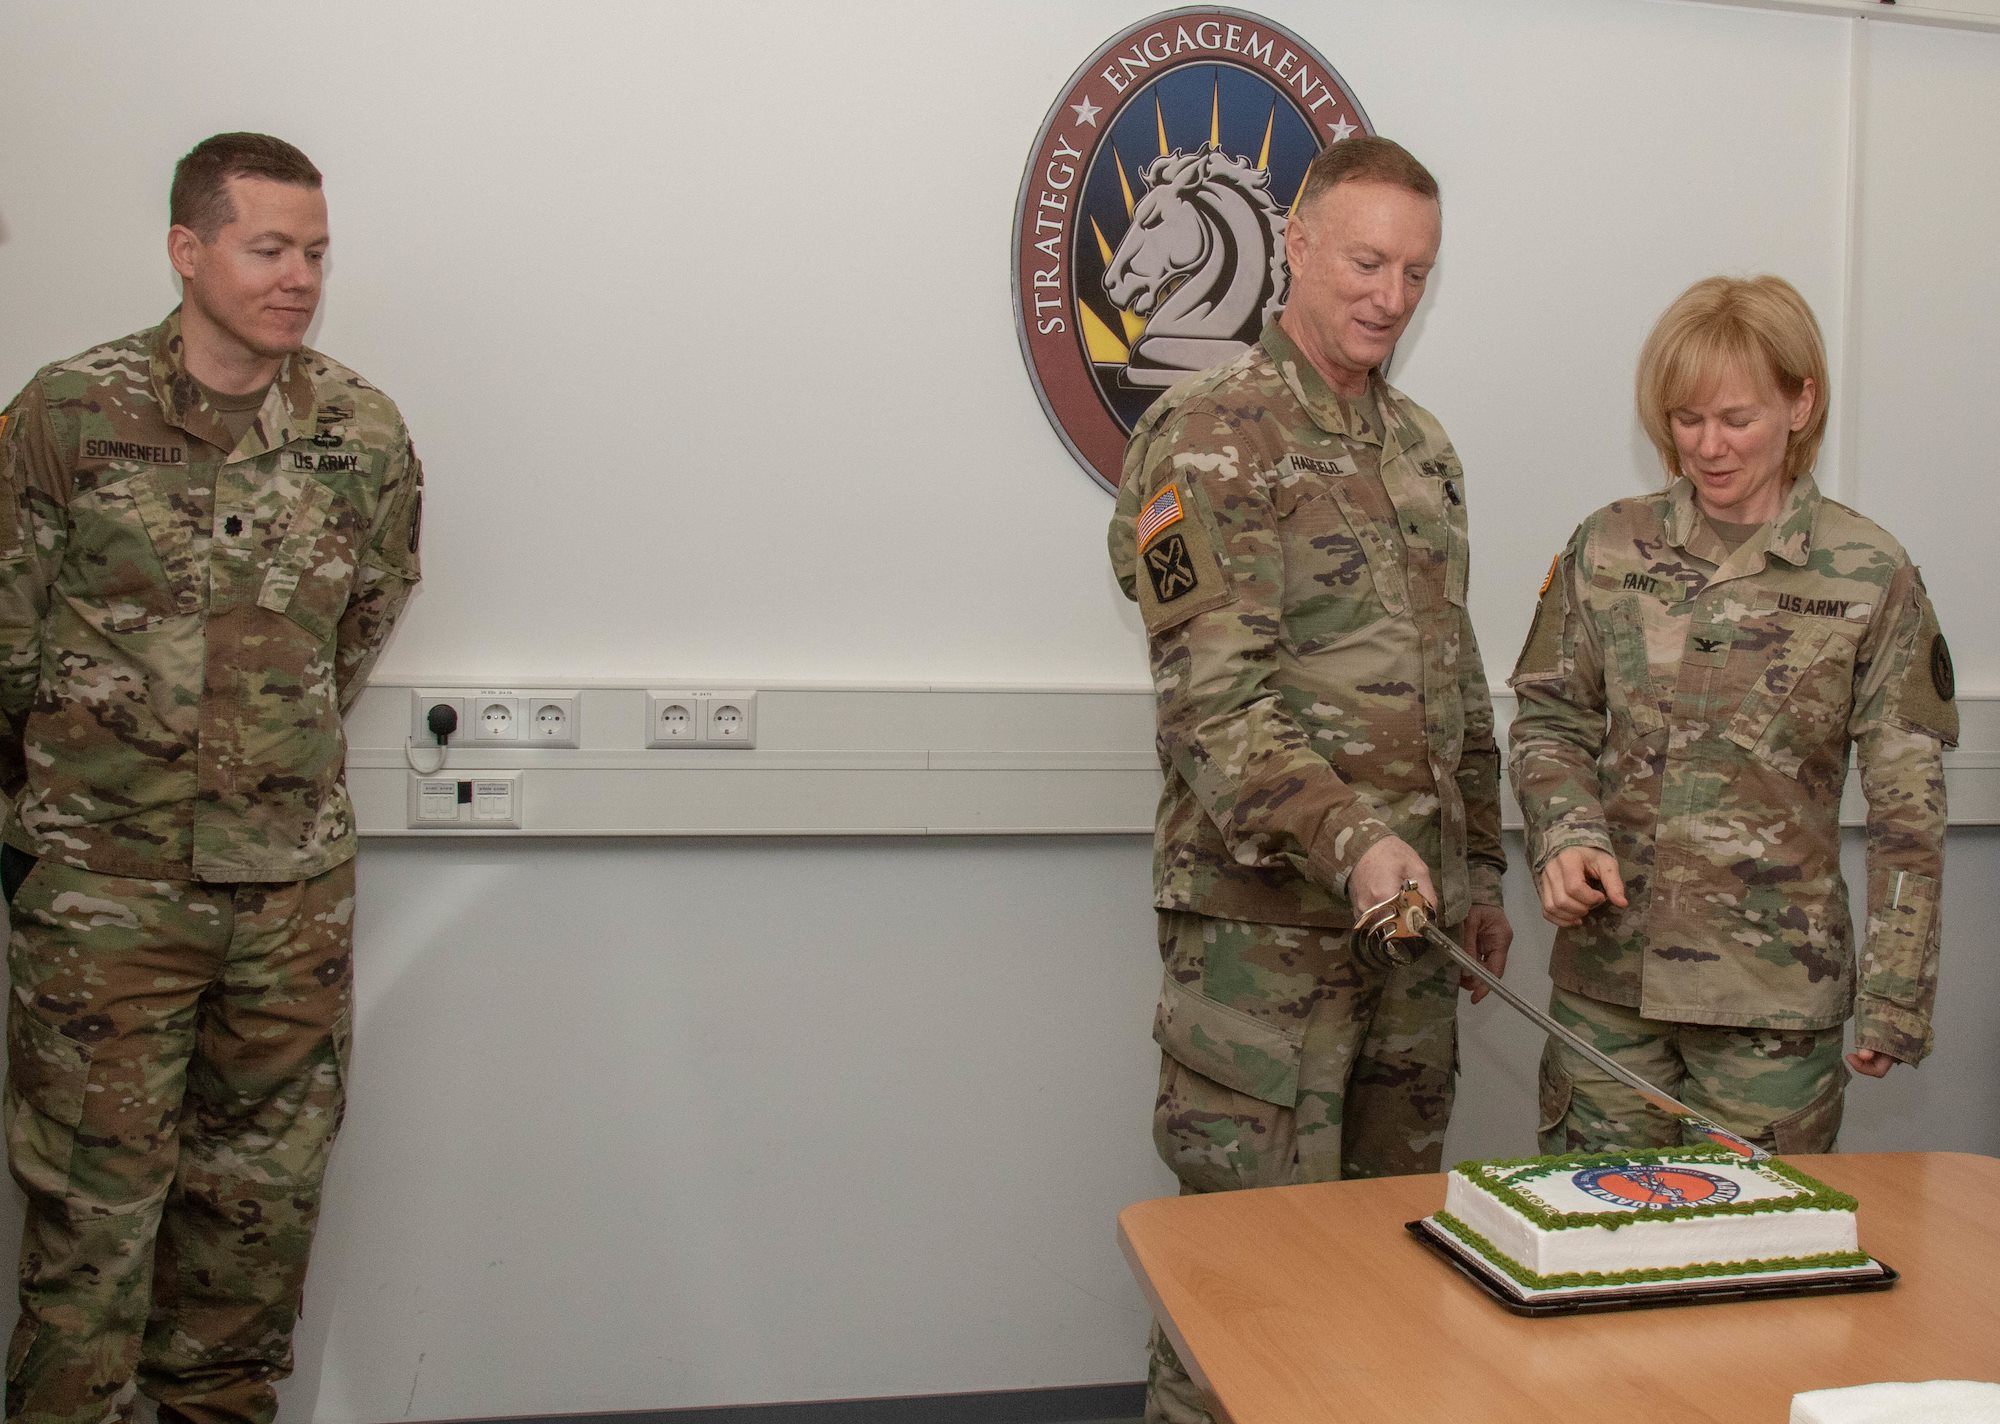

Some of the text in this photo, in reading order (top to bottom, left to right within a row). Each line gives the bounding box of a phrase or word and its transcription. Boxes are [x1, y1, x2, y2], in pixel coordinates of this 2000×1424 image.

[1100, 21, 1337, 115] ENGAGEMENT
[1033, 134, 1083, 335] STRATEGY
[86, 439, 182, 463] SONNENFELD
[1623, 572, 1660, 593] FANT
[1589, 1188, 1662, 1210] GUARD
